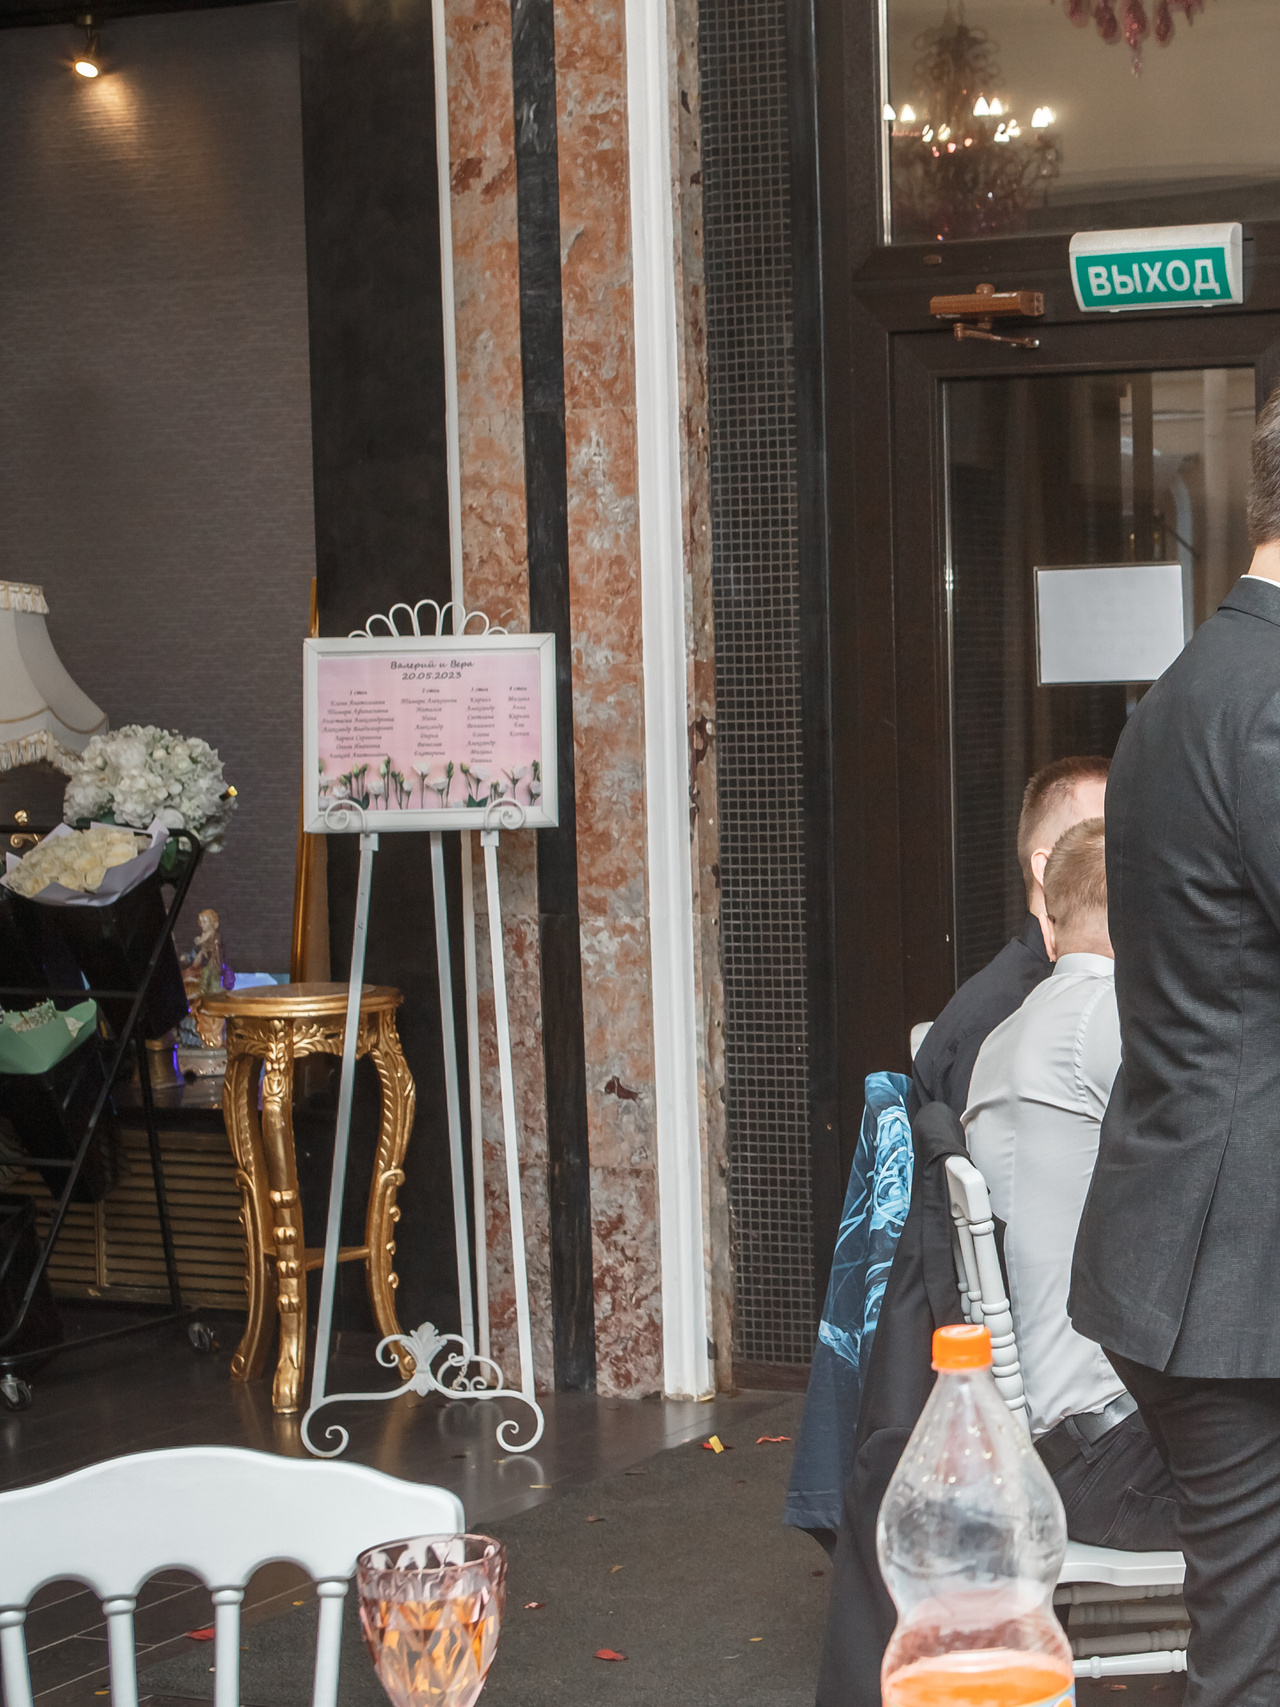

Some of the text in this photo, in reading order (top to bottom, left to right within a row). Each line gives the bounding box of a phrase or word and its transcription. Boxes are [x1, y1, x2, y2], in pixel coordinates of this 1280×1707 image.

[1088, 259, 1221, 296] ВЫХОД
[391, 660, 436, 671] Валерий
[450, 659, 475, 669] Вера
[402, 671, 462, 680] 20.05.2023
